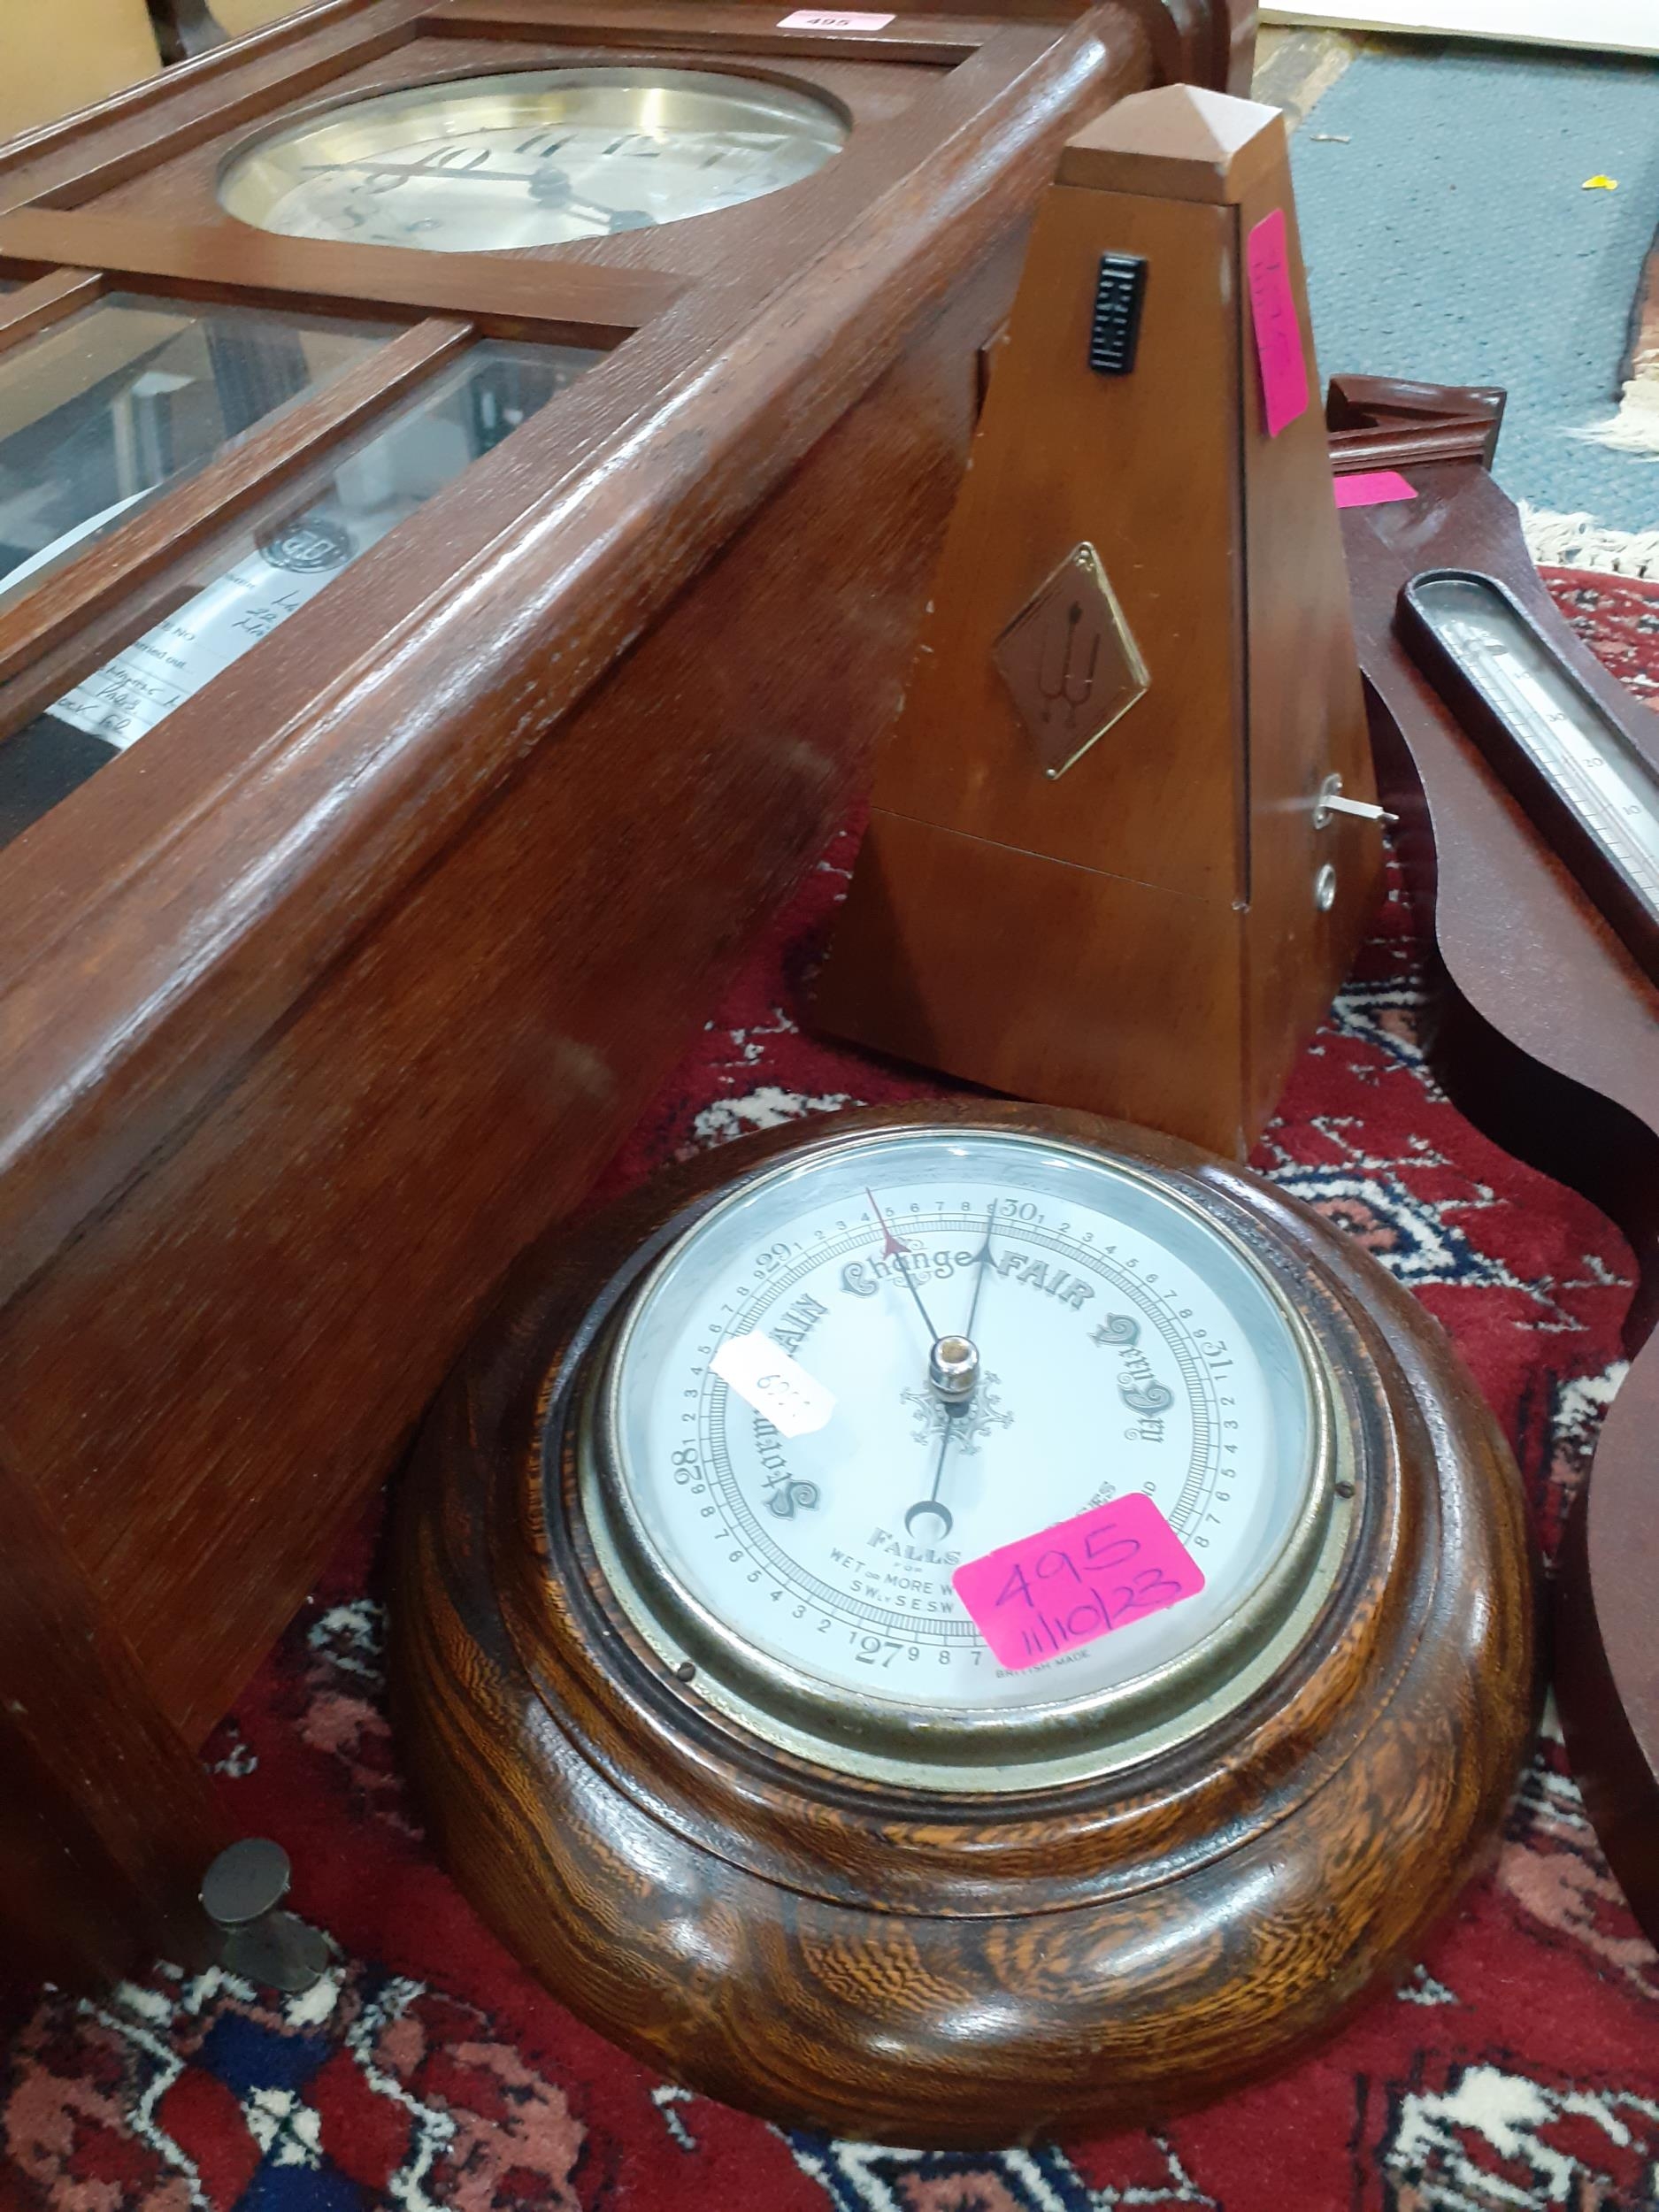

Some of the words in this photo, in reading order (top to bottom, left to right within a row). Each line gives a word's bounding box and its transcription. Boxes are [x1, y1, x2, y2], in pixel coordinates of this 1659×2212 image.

[806, 18, 851, 27] 495
[1583, 757, 1604, 769] 20
[1622, 805, 1641, 817] 10
[885, 1207, 895, 1217] 5
[910, 1203, 920, 1213] 6
[936, 1202, 946, 1211] 7
[962, 1202, 971, 1211] 8
[1000, 1198, 1038, 1221] 30
[861, 1212, 872, 1222] 4
[1037, 1214, 1046, 1225] 1
[835, 1221, 848, 1231] 3
[1059, 1222, 1071, 1233] 2
[814, 1231, 826, 1240] 2
[1082, 1232, 1094, 1242] 3
[794, 1242, 803, 1252] 1
[1104, 1245, 1118, 1254] 4
[756, 1243, 792, 1272] 29
[1125, 1258, 1140, 1268] 5
[753, 1270, 766, 1279] 9
[839, 1249, 977, 1298] Change
[1146, 1273, 1158, 1283] 6
[996, 1249, 1095, 1310] FAIR
[736, 1286, 750, 1296] 8
[1164, 1289, 1178, 1300] 7
[721, 1304, 733, 1315] 7
[1179, 1309, 1193, 1319] 8
[709, 1324, 722, 1333] 6
[768, 1293, 827, 1357] AIN
[1193, 1329, 1207, 1338] 9
[698, 1346, 711, 1355] 5
[1202, 1340, 1233, 1368] 31
[690, 1366, 703, 1376] 4
[684, 1389, 698, 1398] 3
[1221, 1396, 1235, 1406] 2
[681, 1414, 695, 1423] 2
[1224, 1420, 1239, 1430] 3
[1224, 1444, 1239, 1454] 4
[671, 1448, 703, 1485] 28
[751, 1409, 821, 1521] Storm
[1221, 1468, 1236, 1479] 5
[691, 1484, 706, 1494] 9
[1216, 1491, 1231, 1502] 6
[701, 1506, 716, 1517] 8
[1205, 1514, 1221, 1525] 7
[714, 1529, 730, 1540] 7
[865, 1526, 962, 1565] FALLS
[1194, 1536, 1210, 1548] 8
[729, 1550, 744, 1563] 6
[830, 1547, 866, 1573] WET
[883, 1572, 934, 1594] MORE
[995, 1524, 1141, 1608] 495
[747, 1571, 762, 1583] 5
[770, 1591, 783, 1601] 4
[792, 1605, 807, 1618] 3
[1021, 1568, 1183, 1655] 11/10/23
[817, 1619, 832, 1633] 2
[849, 1632, 857, 1644] 1
[855, 1636, 903, 1668] 27
[908, 1647, 920, 1662] 9
[938, 1650, 950, 1665] 8
[1054, 1649, 1091, 1665] MADE
[970, 1650, 982, 1666] 7
